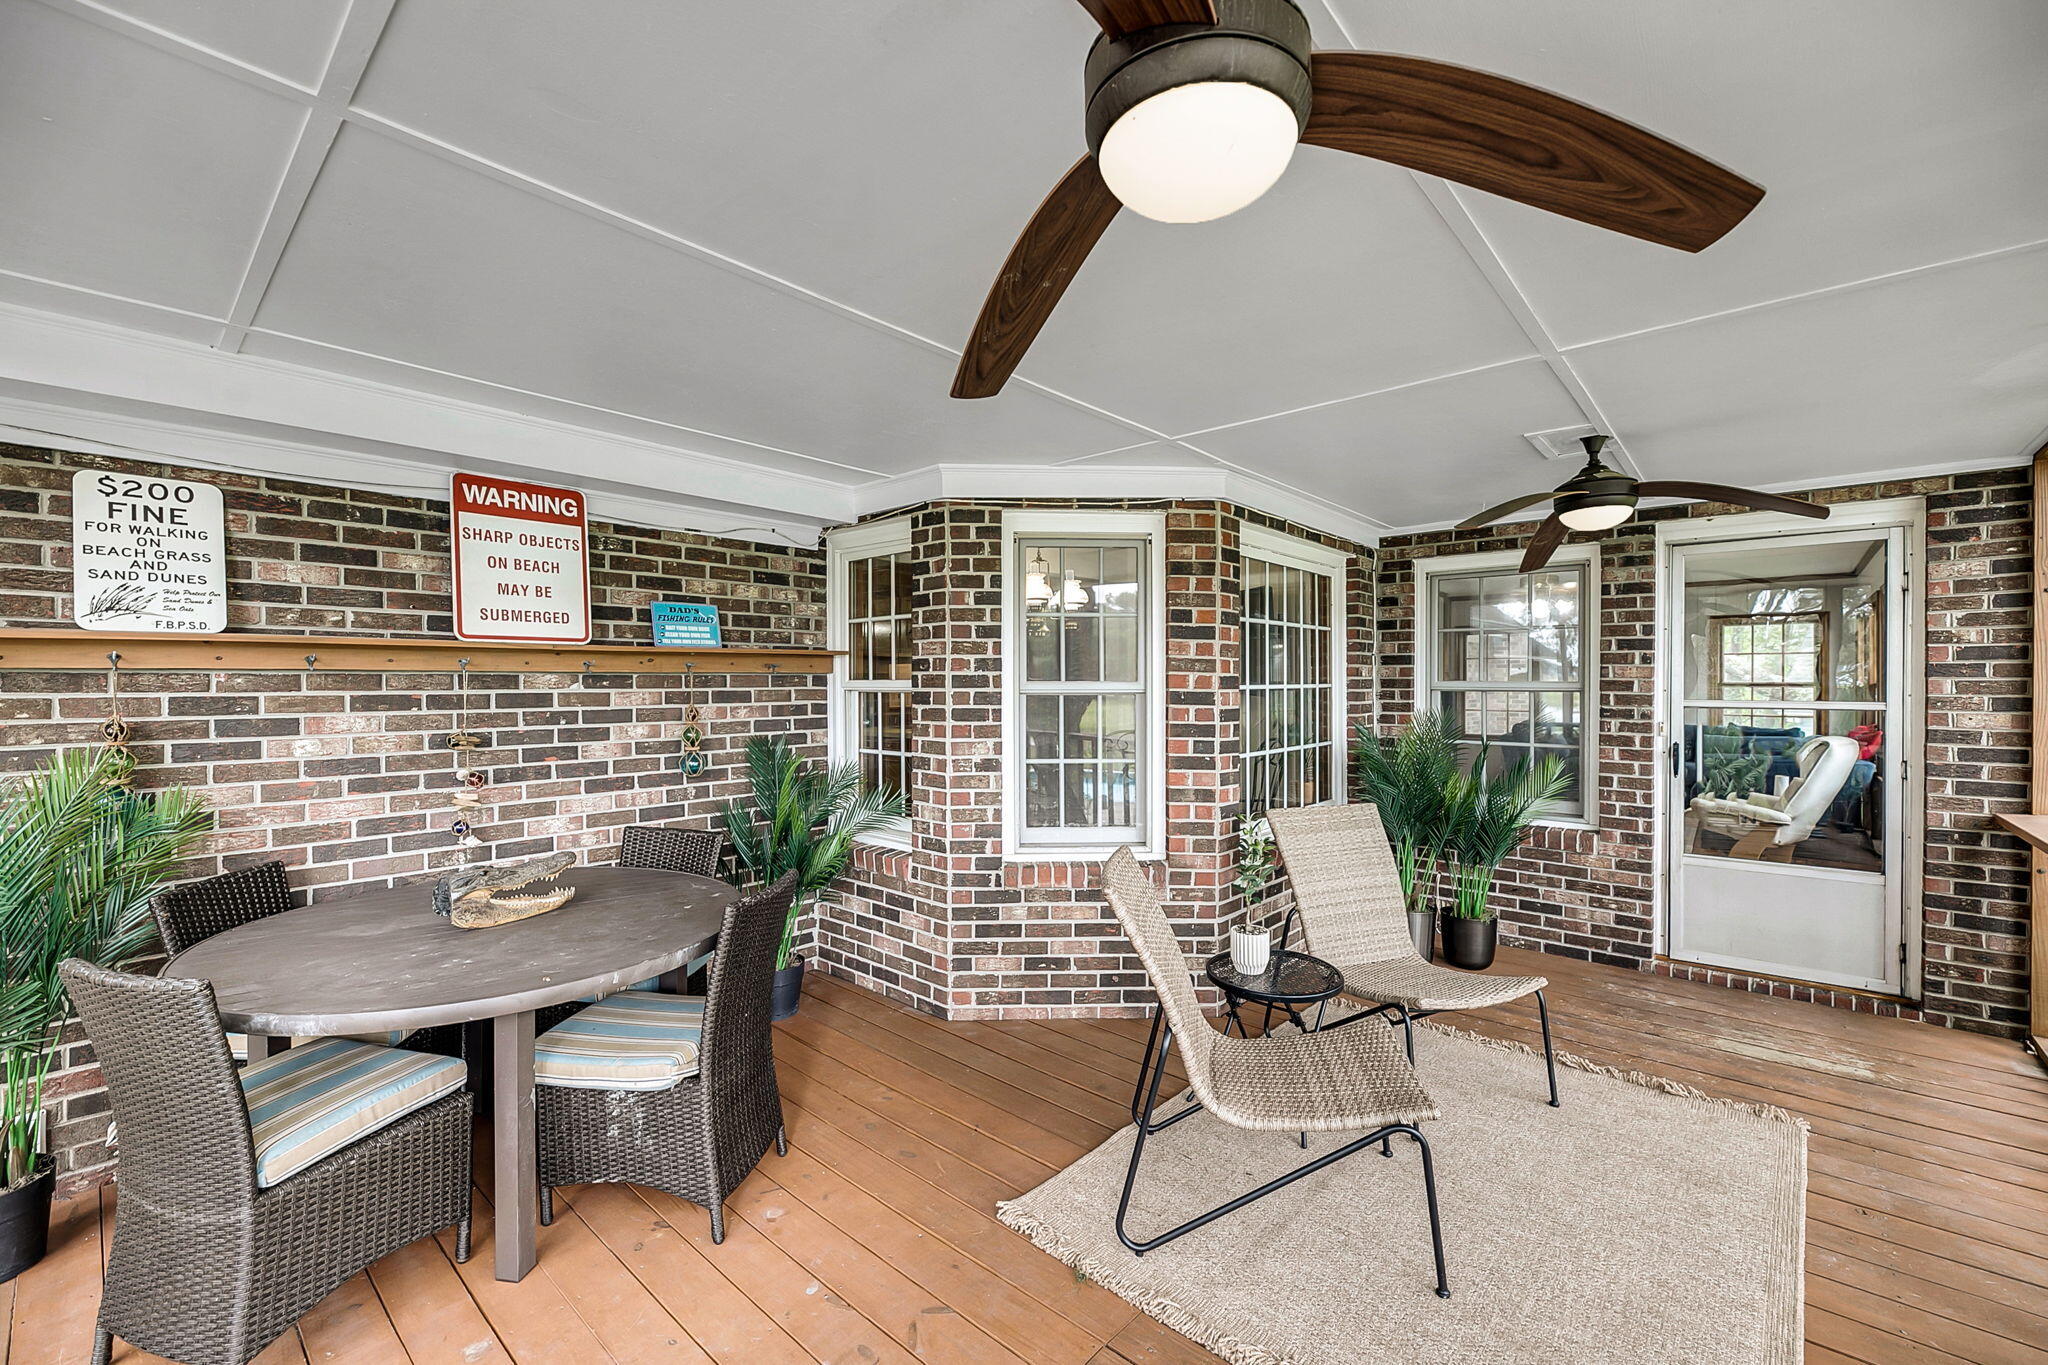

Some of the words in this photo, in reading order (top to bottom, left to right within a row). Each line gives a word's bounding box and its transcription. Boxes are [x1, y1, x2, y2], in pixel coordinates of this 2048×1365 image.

[97, 475, 195, 504] $200
[461, 482, 578, 518] WARNING
[108, 501, 189, 526] FINE
[84, 521, 121, 533] FOR
[129, 524, 208, 541] WALKING
[462, 527, 513, 544] SHARP
[519, 533, 580, 551] OBJECTS
[136, 537, 161, 548] ON
[82, 544, 146, 558] BEACH
[154, 550, 212, 563] GRASS
[130, 560, 168, 571] AND
[487, 555, 508, 569] ON
[514, 558, 560, 574] BEACH
[88, 569, 139, 581] SAND
[148, 572, 207, 585] DUNES
[497, 582, 529, 597] MAY
[535, 586, 552, 598] BE
[480, 607, 570, 625] SUBMERGED
[658, 614, 690, 622] FISHING
[692, 616, 715, 624] RULES
[669, 606, 700, 614] DAD'S
[155, 620, 211, 630] F.B.P.S.D.
